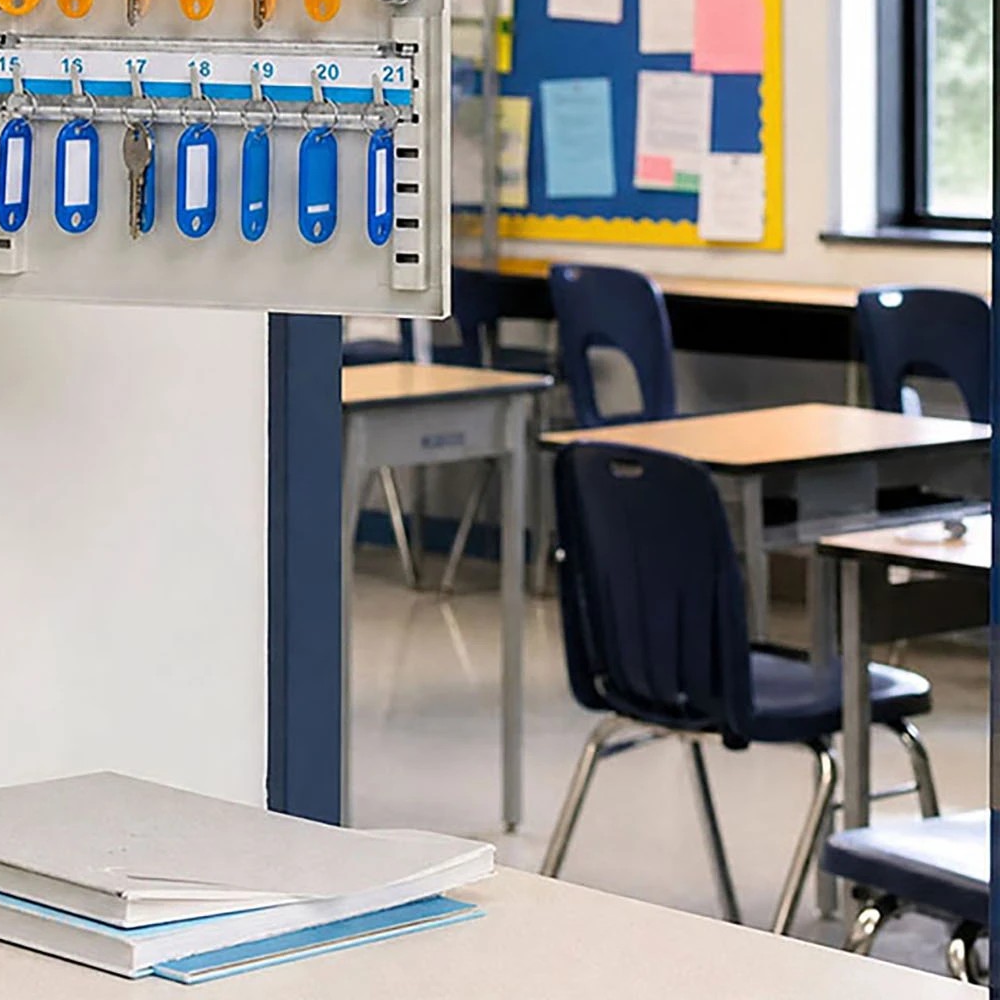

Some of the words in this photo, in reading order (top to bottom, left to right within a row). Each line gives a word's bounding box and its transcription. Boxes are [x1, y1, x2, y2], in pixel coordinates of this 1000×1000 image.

[125, 59, 147, 74] 17
[316, 64, 340, 81] 20
[382, 66, 405, 83] 21
